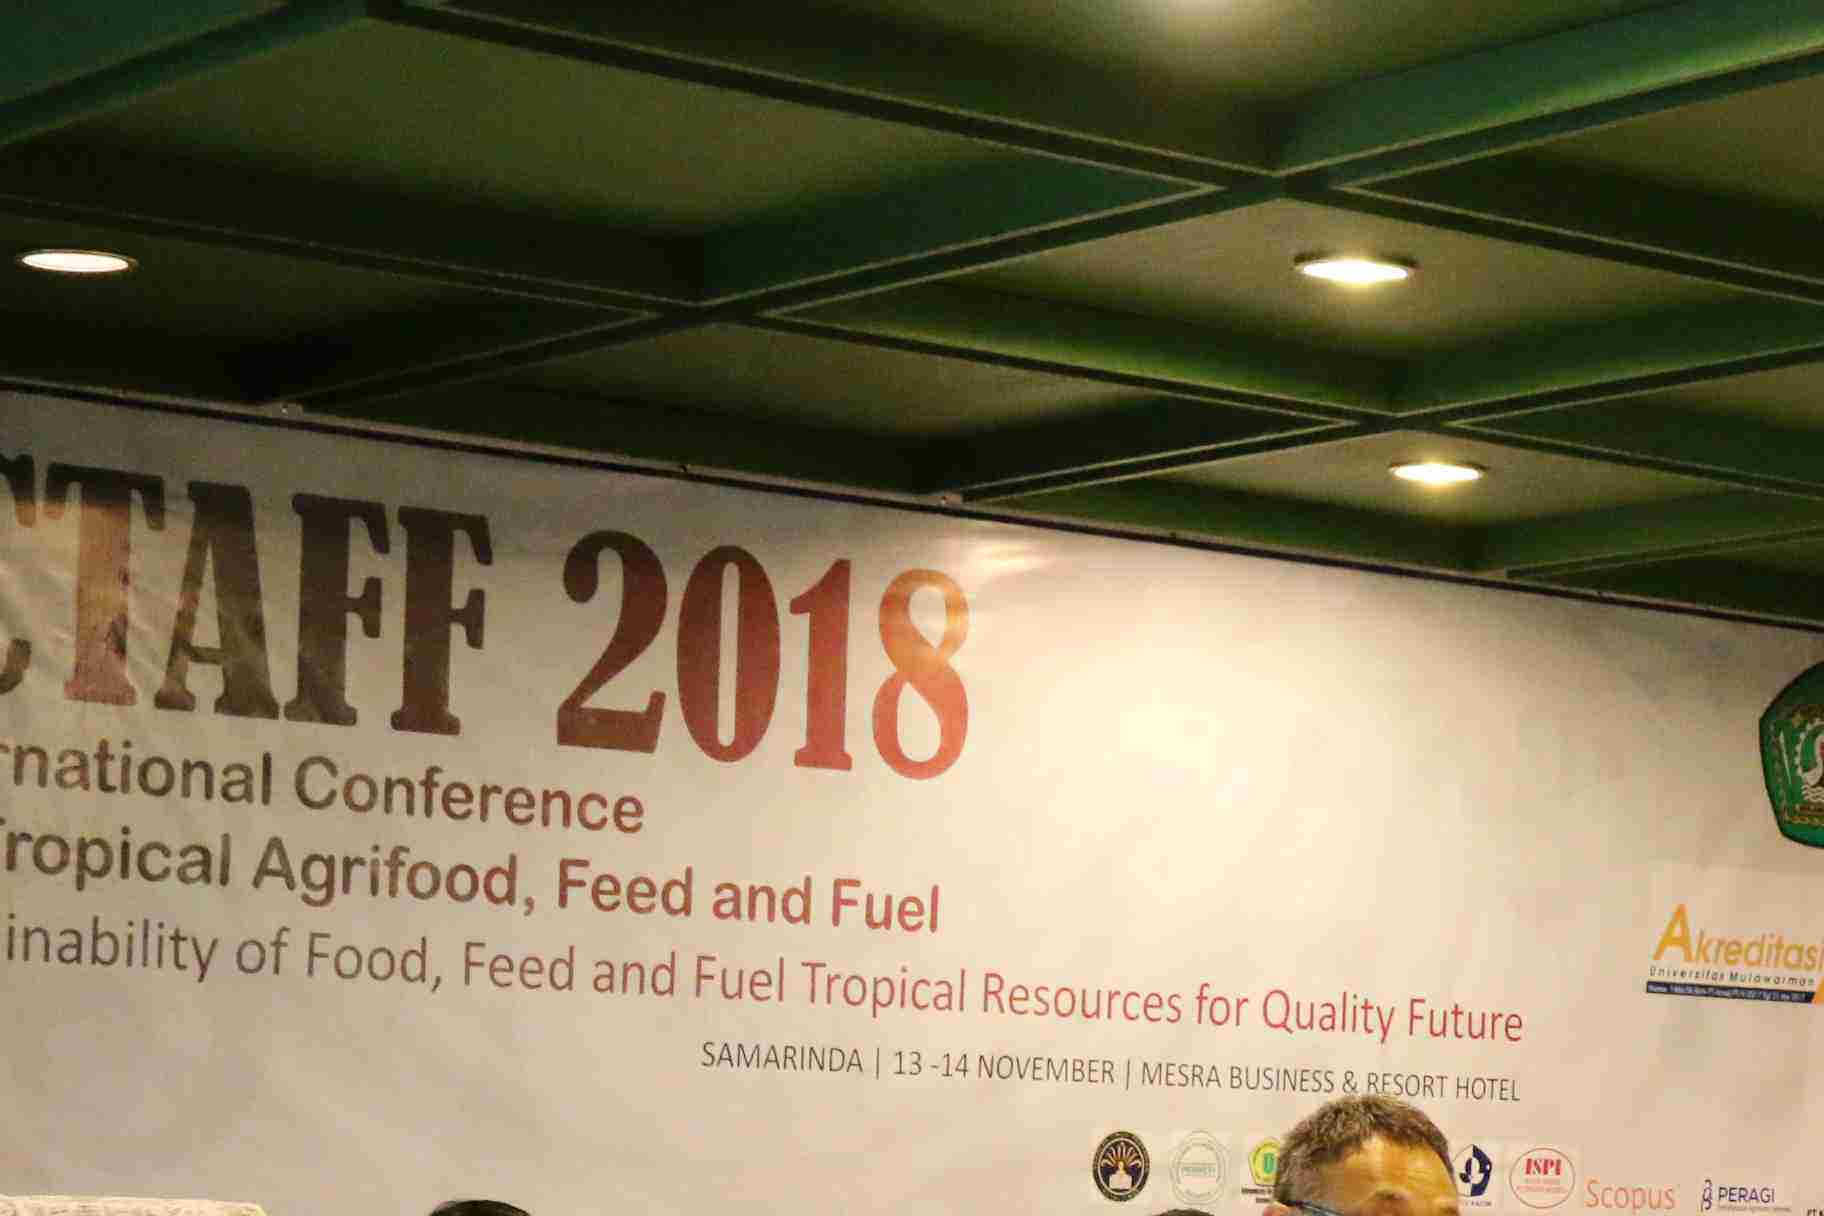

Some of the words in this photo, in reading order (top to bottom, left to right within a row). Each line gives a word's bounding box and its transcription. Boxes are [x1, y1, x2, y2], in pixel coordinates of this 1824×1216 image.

[0, 453, 493, 736] TAFF
[556, 531, 969, 780] 2018
[0, 738, 272, 808] national
[294, 755, 645, 835] Conference
[0, 816, 231, 892] ropical
[252, 836, 535, 918] Agrifood,
[557, 858, 694, 918] Feed
[712, 875, 812, 925] and
[831, 879, 940, 933] Fuel
[236, 926, 291, 976] of
[306, 932, 443, 993] Food,
[463, 941, 575, 992] Feed
[592, 950, 676, 998] and
[694, 954, 784, 1003] Fuel
[801, 961, 966, 1019] Tropical
[983, 972, 1182, 1025] Resources
[1195, 982, 1249, 1028] for
[1262, 987, 1396, 1045] Quality
[1408, 997, 1523, 1042] Future
[701, 1041, 863, 1073] SAMARINDA
[893, 1050, 923, 1076] 13
[977, 1053, 1115, 1085] NOVEMBER
[1141, 1060, 1222, 1089] MESRA
[1229, 1064, 1335, 1094] BUSINESS
[1367, 1072, 1448, 1097] RESORT
[1456, 1076, 1521, 1101] HOTEL
[1586, 1179, 1677, 1215] Scopus
[1718, 1186, 1775, 1204] PERAGI
